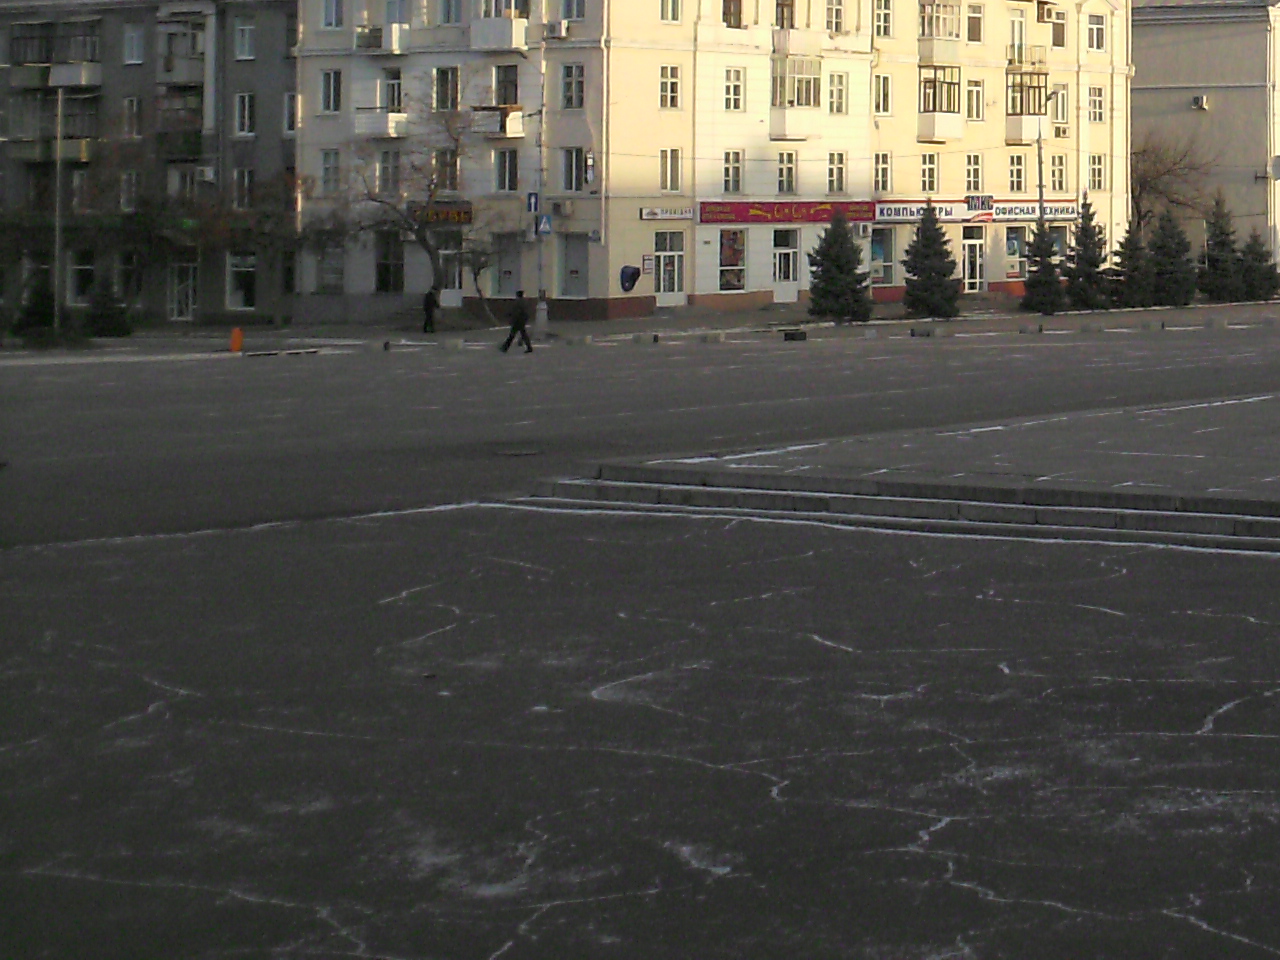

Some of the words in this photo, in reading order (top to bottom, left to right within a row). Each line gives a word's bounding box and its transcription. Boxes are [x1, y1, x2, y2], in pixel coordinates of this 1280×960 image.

[879, 206, 953, 217] КОМПЬЮЕРЫ
[995, 206, 1036, 216] ОФИСНАЯ
[1038, 206, 1075, 215] ЕХНИКА
